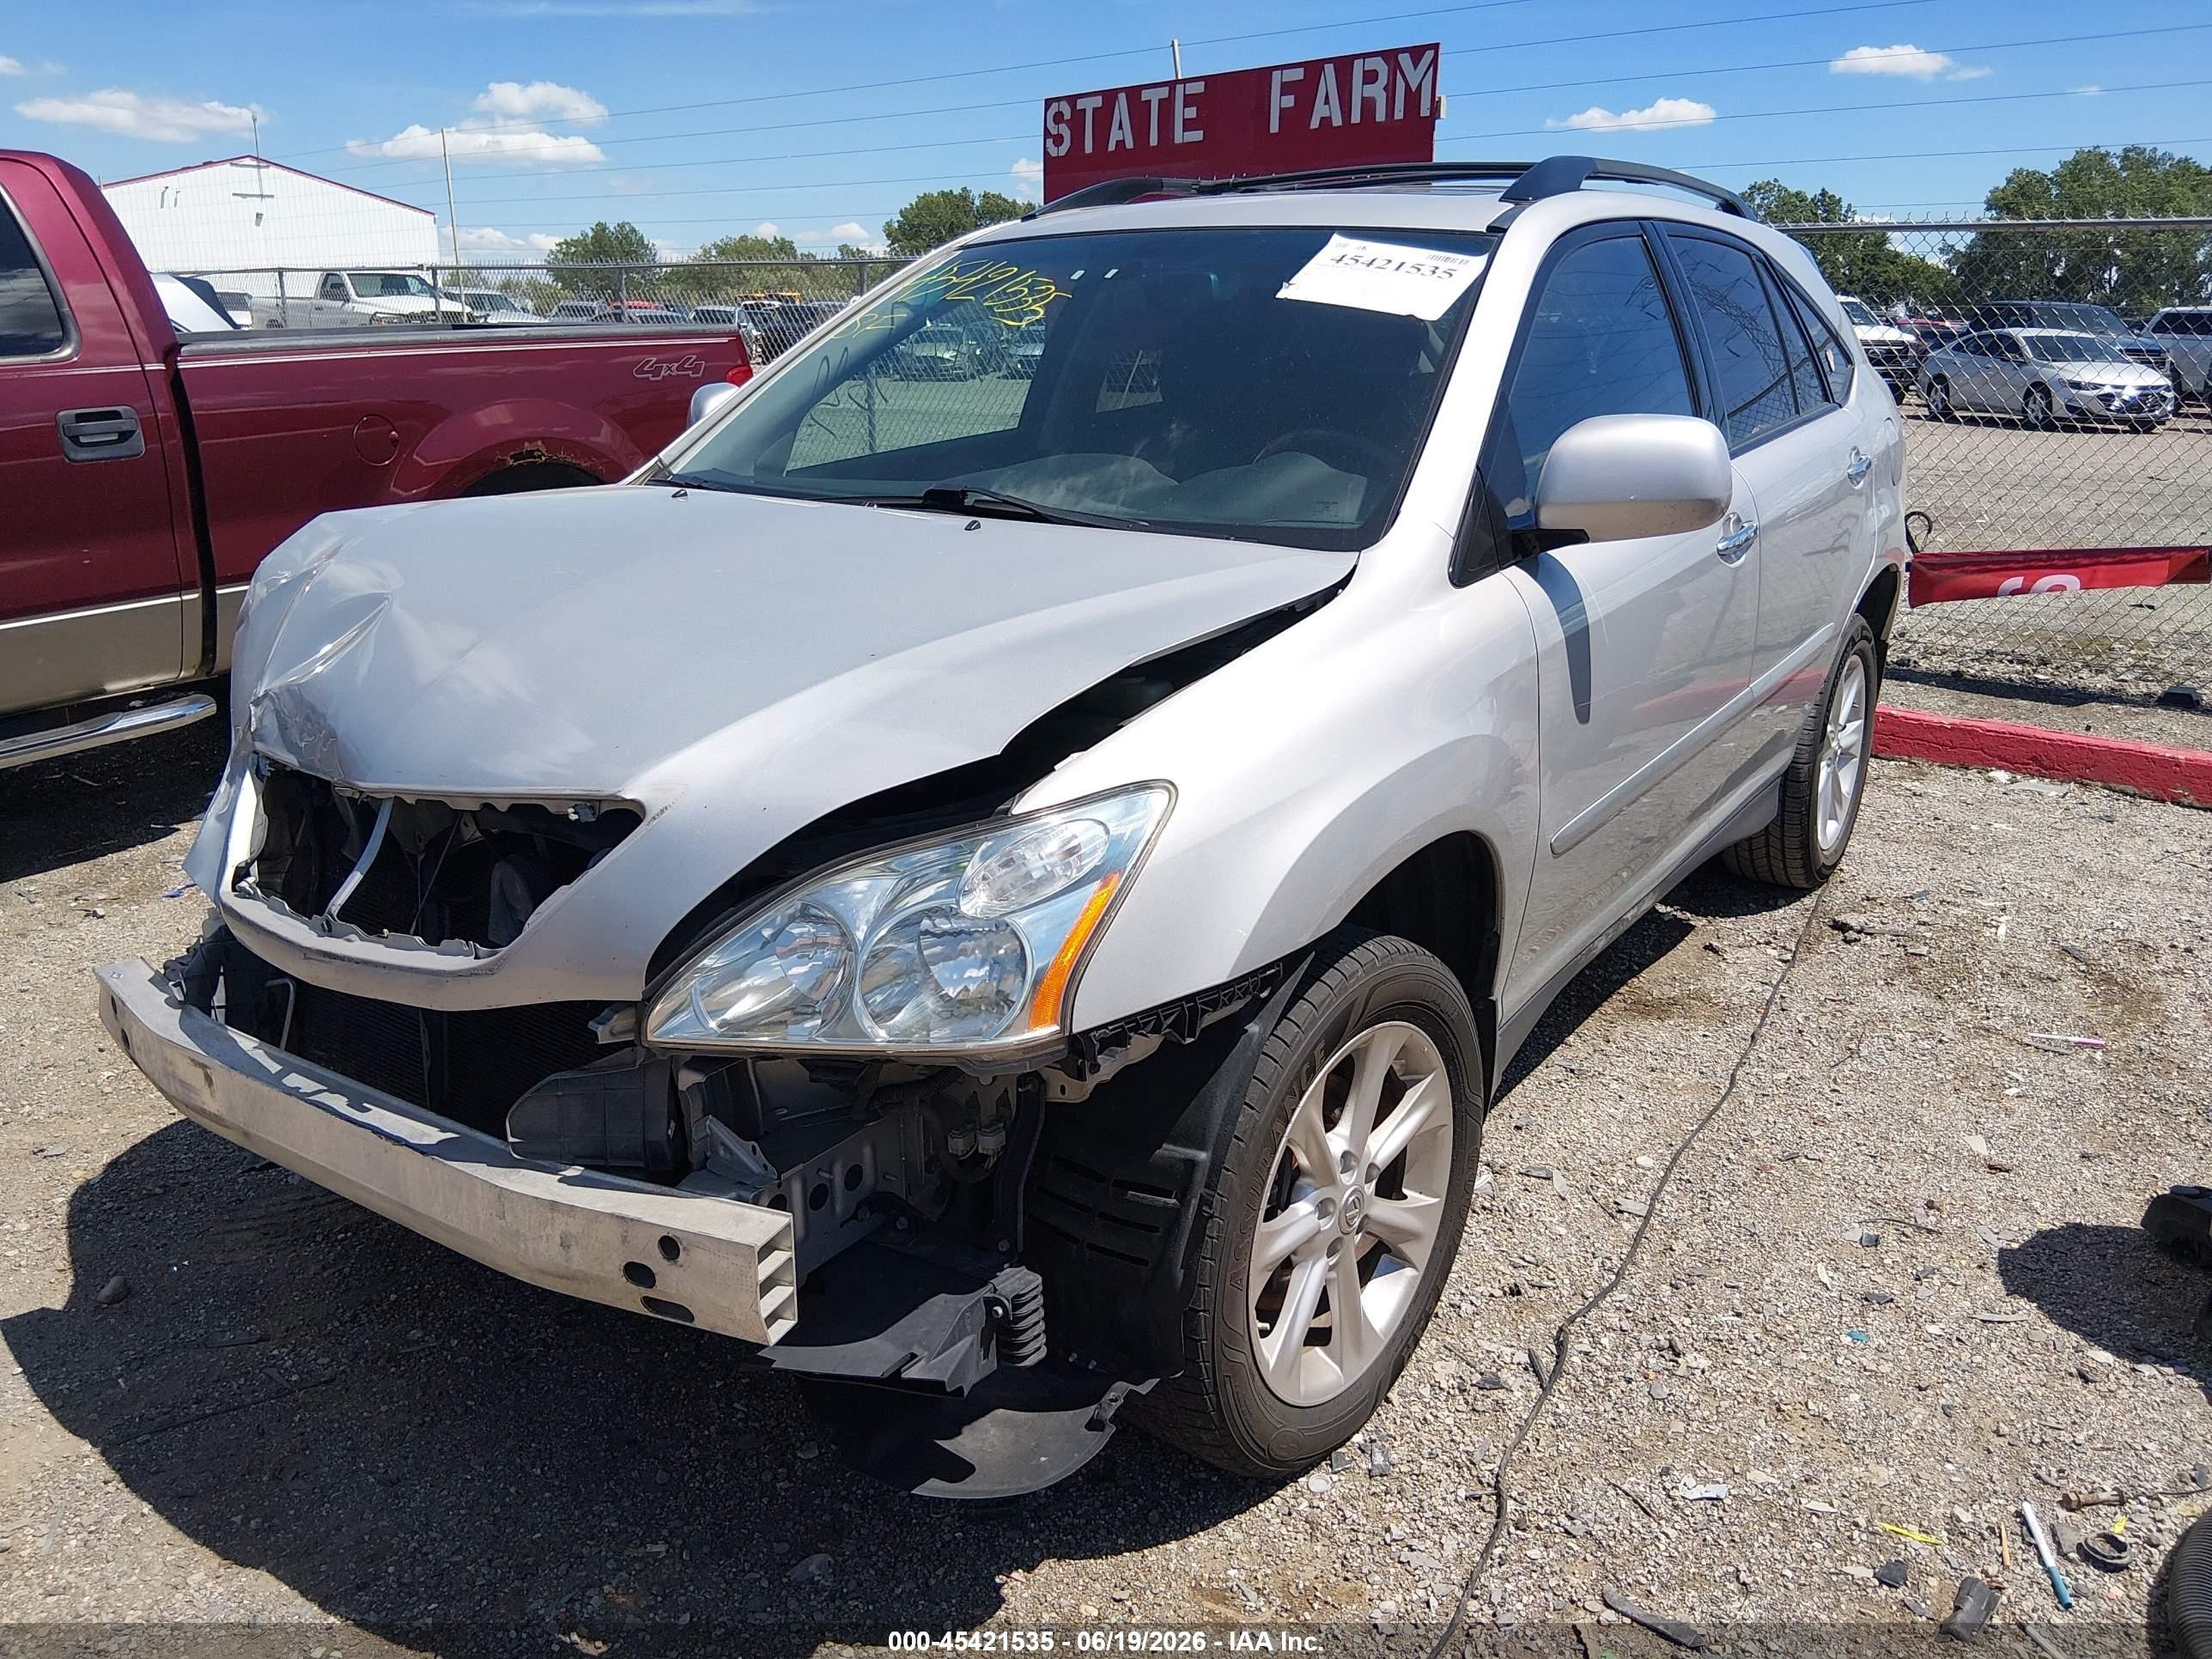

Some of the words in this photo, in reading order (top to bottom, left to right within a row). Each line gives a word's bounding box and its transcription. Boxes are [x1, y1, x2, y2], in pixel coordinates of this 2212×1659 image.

[1045, 81, 1205, 157] STATE
[1269, 49, 1435, 134] FARM
[1330, 252, 1459, 280] 45421535
[633, 355, 706, 381] 4x4
